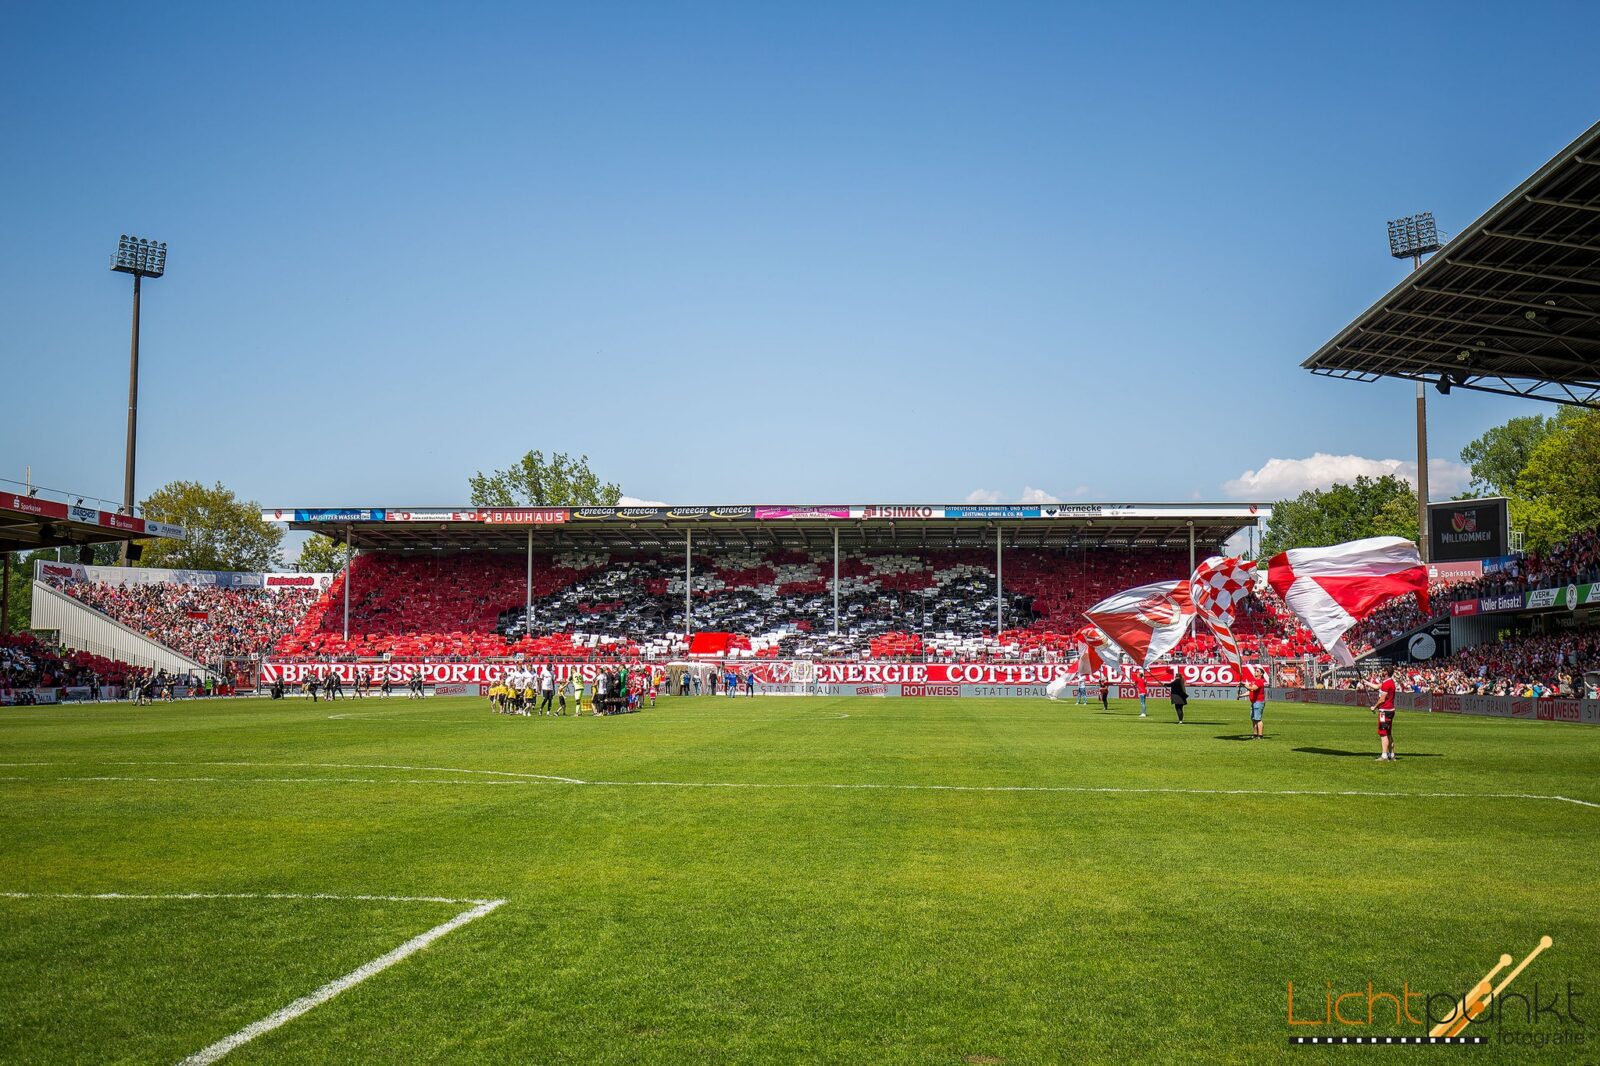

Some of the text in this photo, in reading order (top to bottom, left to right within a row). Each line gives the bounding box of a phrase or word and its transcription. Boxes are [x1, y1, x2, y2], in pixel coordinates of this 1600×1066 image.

[20, 503, 42, 513] Sparkasse
[879, 506, 932, 518] ISIMKO
[309, 513, 338, 521] LAUSITZER
[495, 512, 563, 522] BAUHAUS
[1441, 531, 1491, 544] WILLKOMMEN
[1440, 570, 1476, 578] Sparkasse
[266, 576, 314, 586] Reiseclub
[1480, 598, 1497, 611] Voller
[1498, 595, 1522, 609] Einsatz!
[814, 664, 928, 682] ENERGIE
[1168, 664, 1234, 684] 1966
[903, 686, 959, 695] ROT WEISS
[974, 687, 1047, 696] STATT BRAU
[1147, 688, 1171, 697] WEIS
[1194, 690, 1230, 698] STATT
[1444, 696, 1460, 711] WEISS
[1486, 698, 1509, 713] BRAUN
[1538, 701, 1554, 718] ROT
[1554, 702, 1579, 718] WEISS
